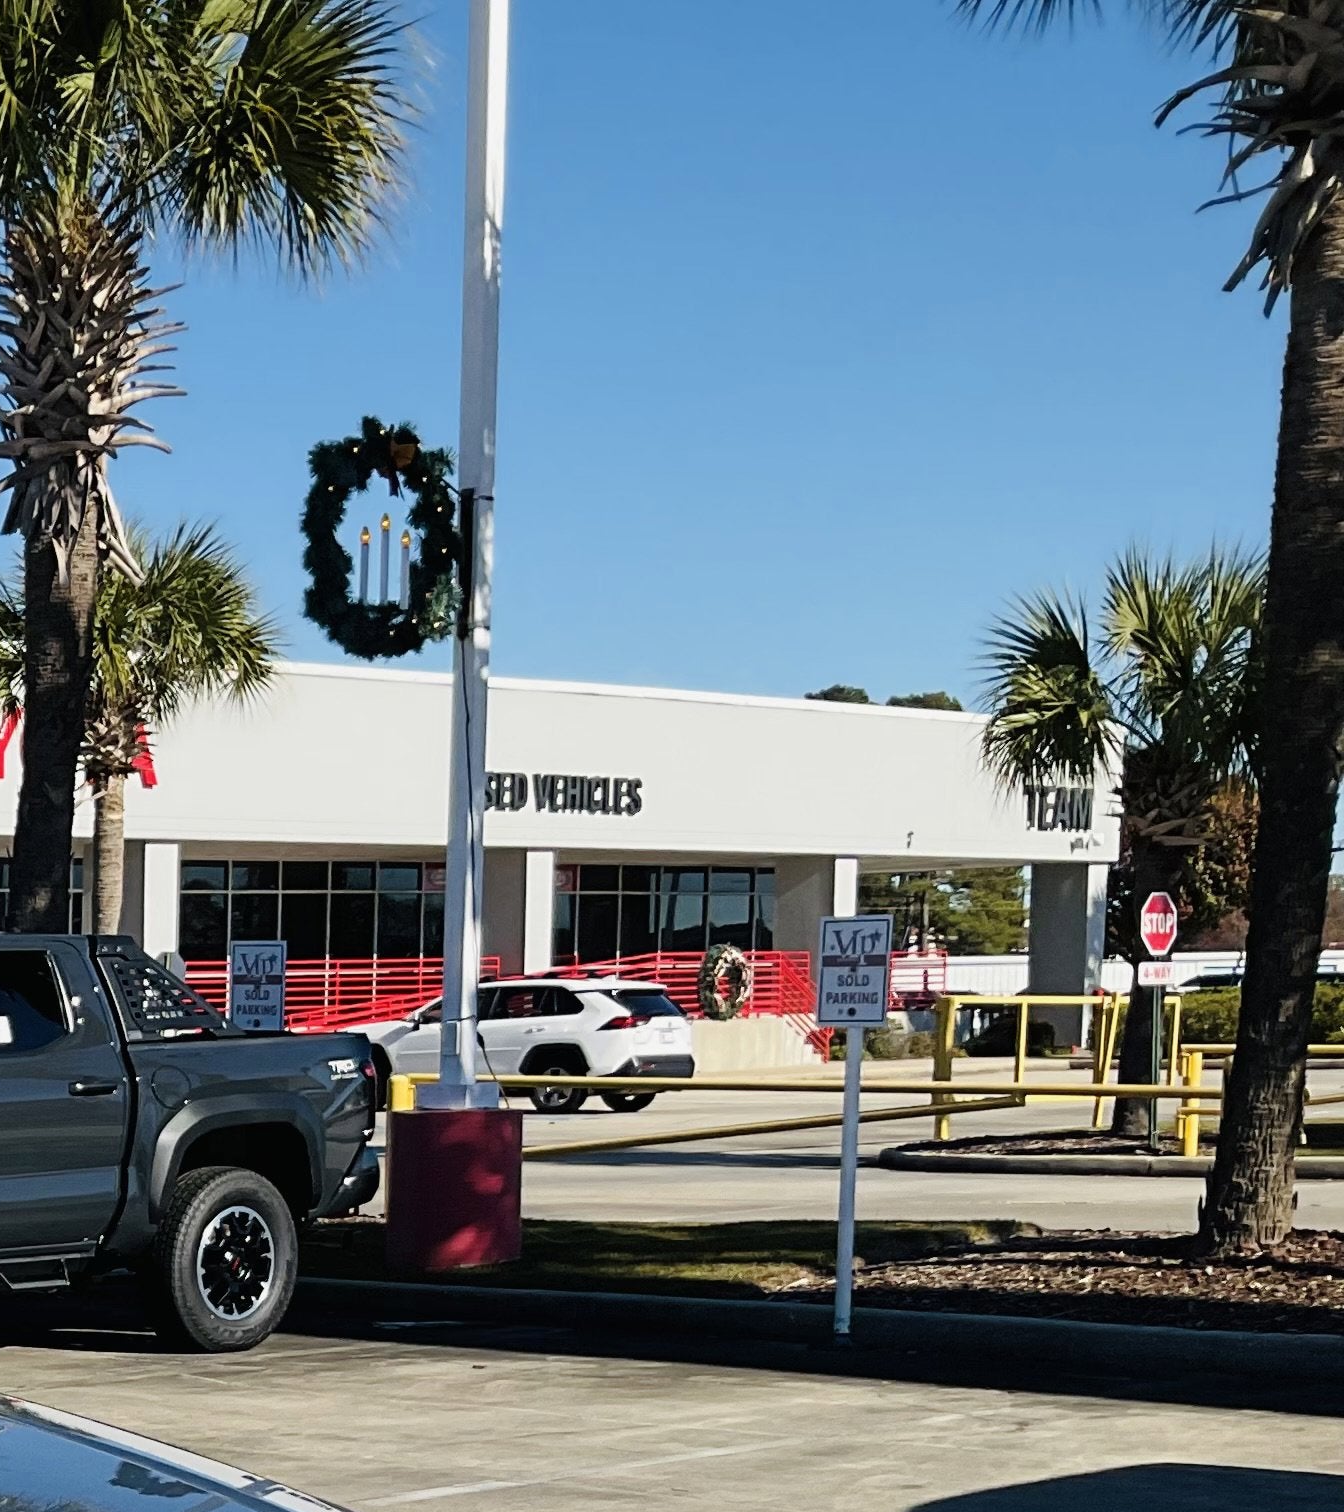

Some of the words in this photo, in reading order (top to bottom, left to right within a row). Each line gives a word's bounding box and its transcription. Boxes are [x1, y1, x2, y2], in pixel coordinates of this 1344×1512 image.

[484, 771, 528, 812] SED
[532, 773, 643, 817] VEHICLES
[1023, 784, 1093, 832] TEAM
[1144, 912, 1174, 934] STOP
[1143, 966, 1171, 978] 4-WAY
[837, 974, 870, 987] SOLD
[244, 989, 271, 1001] SOLD
[825, 991, 879, 1005] PARKING
[236, 1004, 278, 1016] PARKING
